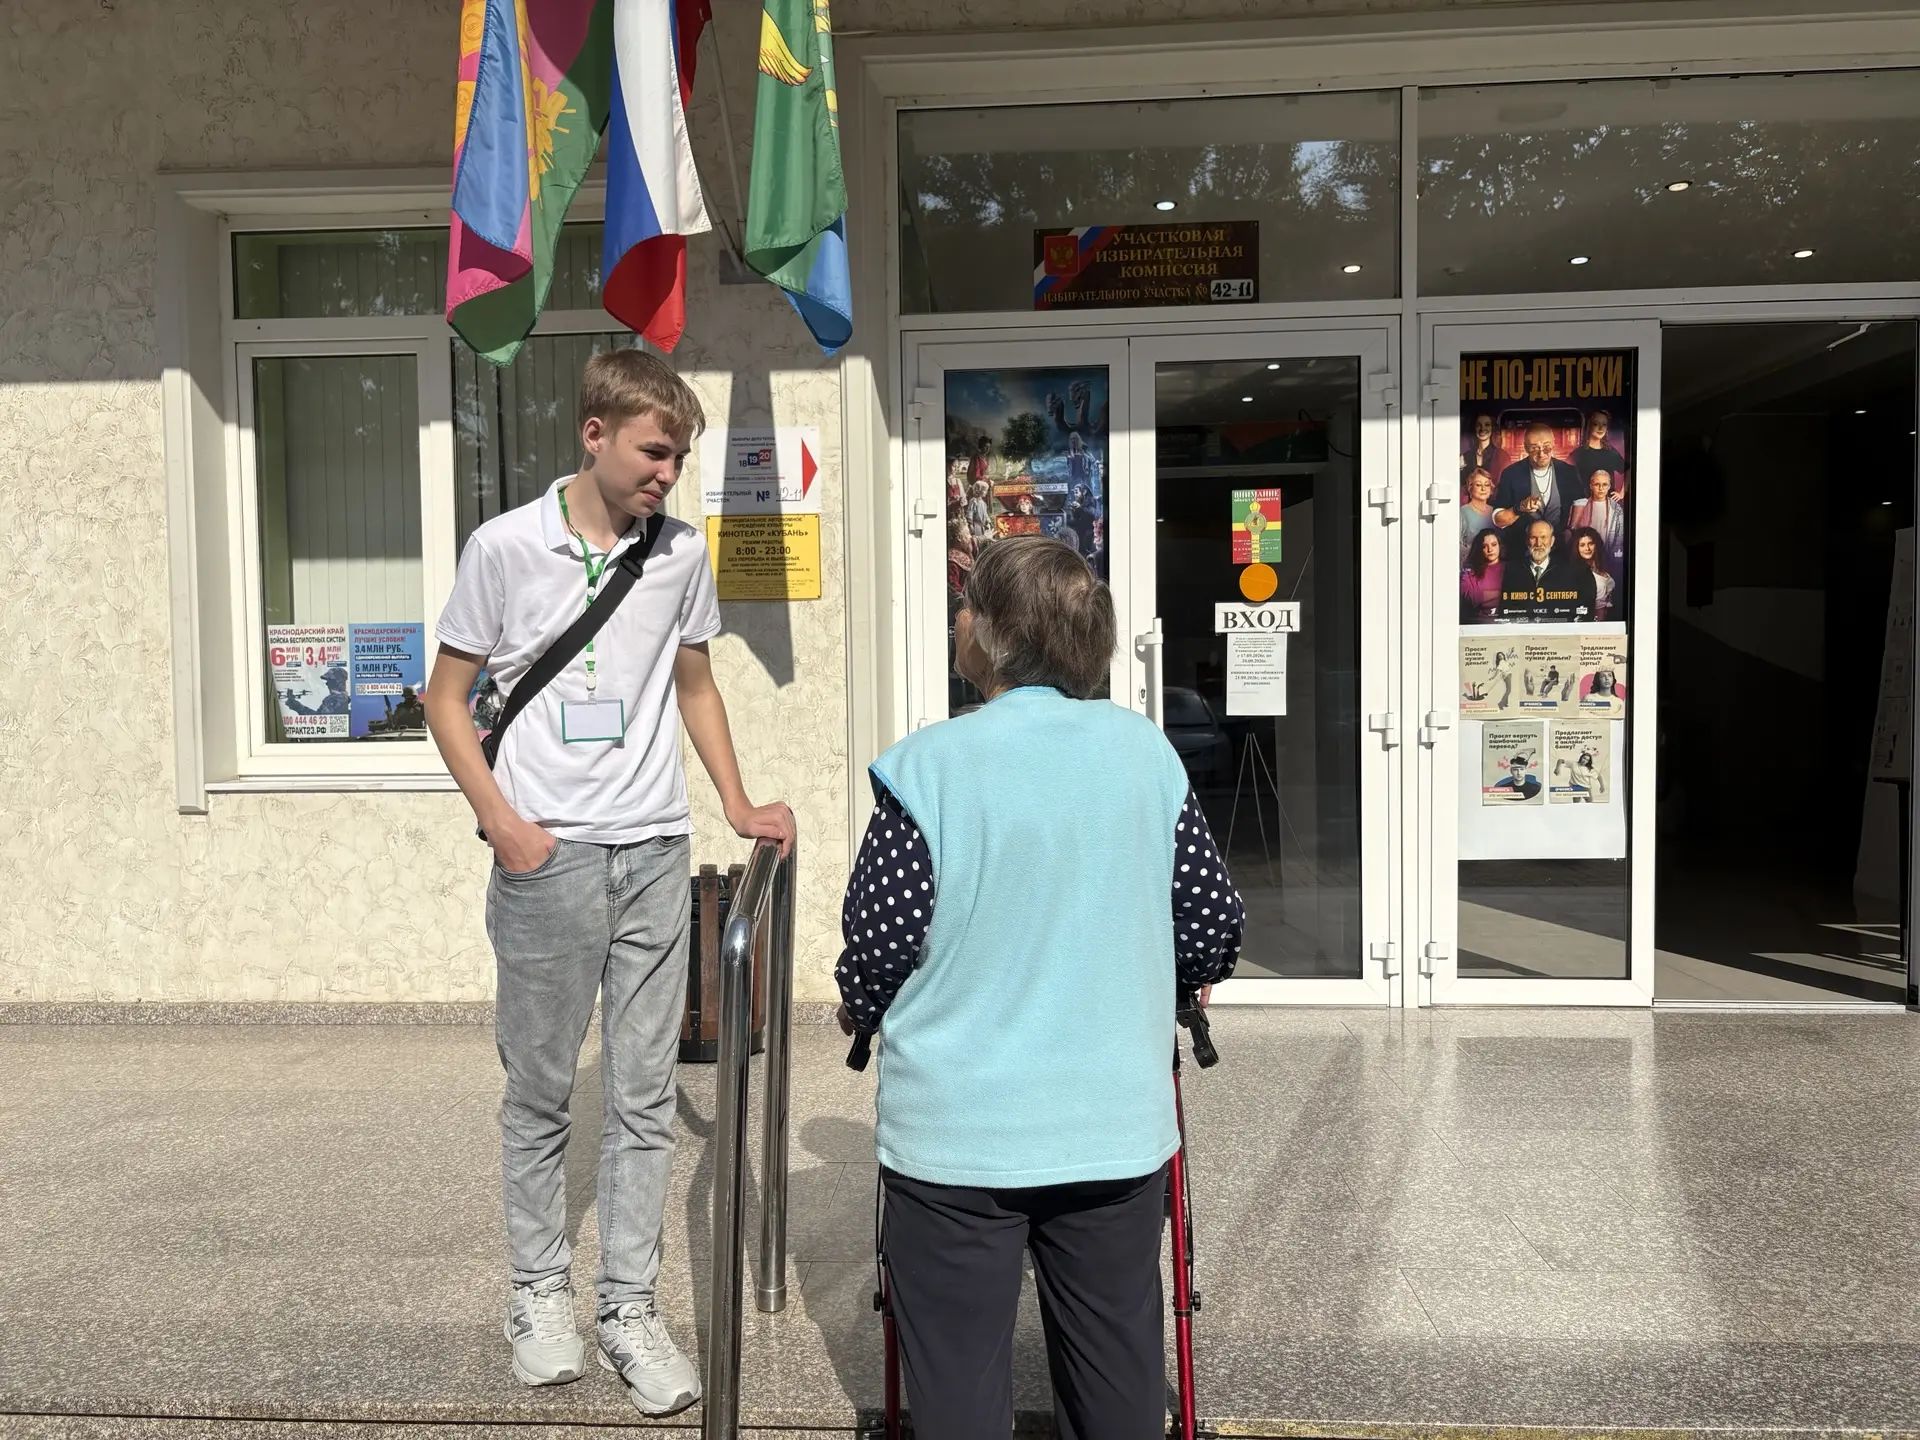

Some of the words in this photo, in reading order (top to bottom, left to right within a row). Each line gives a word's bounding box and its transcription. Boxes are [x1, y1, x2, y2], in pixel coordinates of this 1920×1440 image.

[1113, 229, 1224, 245] УЧАСТКОВАЯ
[1096, 246, 1243, 263] ИЗБИРАТЕЛЬНАЯ
[1120, 264, 1218, 278] КОМИССИЯ
[1043, 287, 1140, 303] ИЗБИРАТЕЛЬНОГО
[1144, 286, 1191, 298] УЧАСТКА
[1212, 281, 1252, 298] 42-11
[1461, 360, 1487, 400] НЕ
[1493, 356, 1623, 401] ПО-ДЕТСКИ
[1234, 489, 1280, 498] ВНИМАНИЕ
[718, 530, 765, 538] КИНОТЕАТР
[736, 547, 756, 555] 8:00
[765, 547, 791, 555] 23:00
[1511, 592, 1528, 600] КИНО
[1536, 587, 1545, 602] 3
[1546, 591, 1578, 600] СЕНТЯБРЯ
[1223, 609, 1293, 631] ВХОД
[269, 628, 326, 636] КРАСНОДАРСКИЙ
[327, 626, 344, 634] КРАЙ
[270, 636, 289, 644] ВОЙСКА
[367, 645, 384, 653] МЛН
[387, 644, 404, 653] РУБ.
[271, 647, 286, 666] 6
[383, 663, 400, 672] РУБ.
[295, 716, 308, 724] 444
[309, 716, 318, 724] 46
[319, 716, 328, 724] 23
